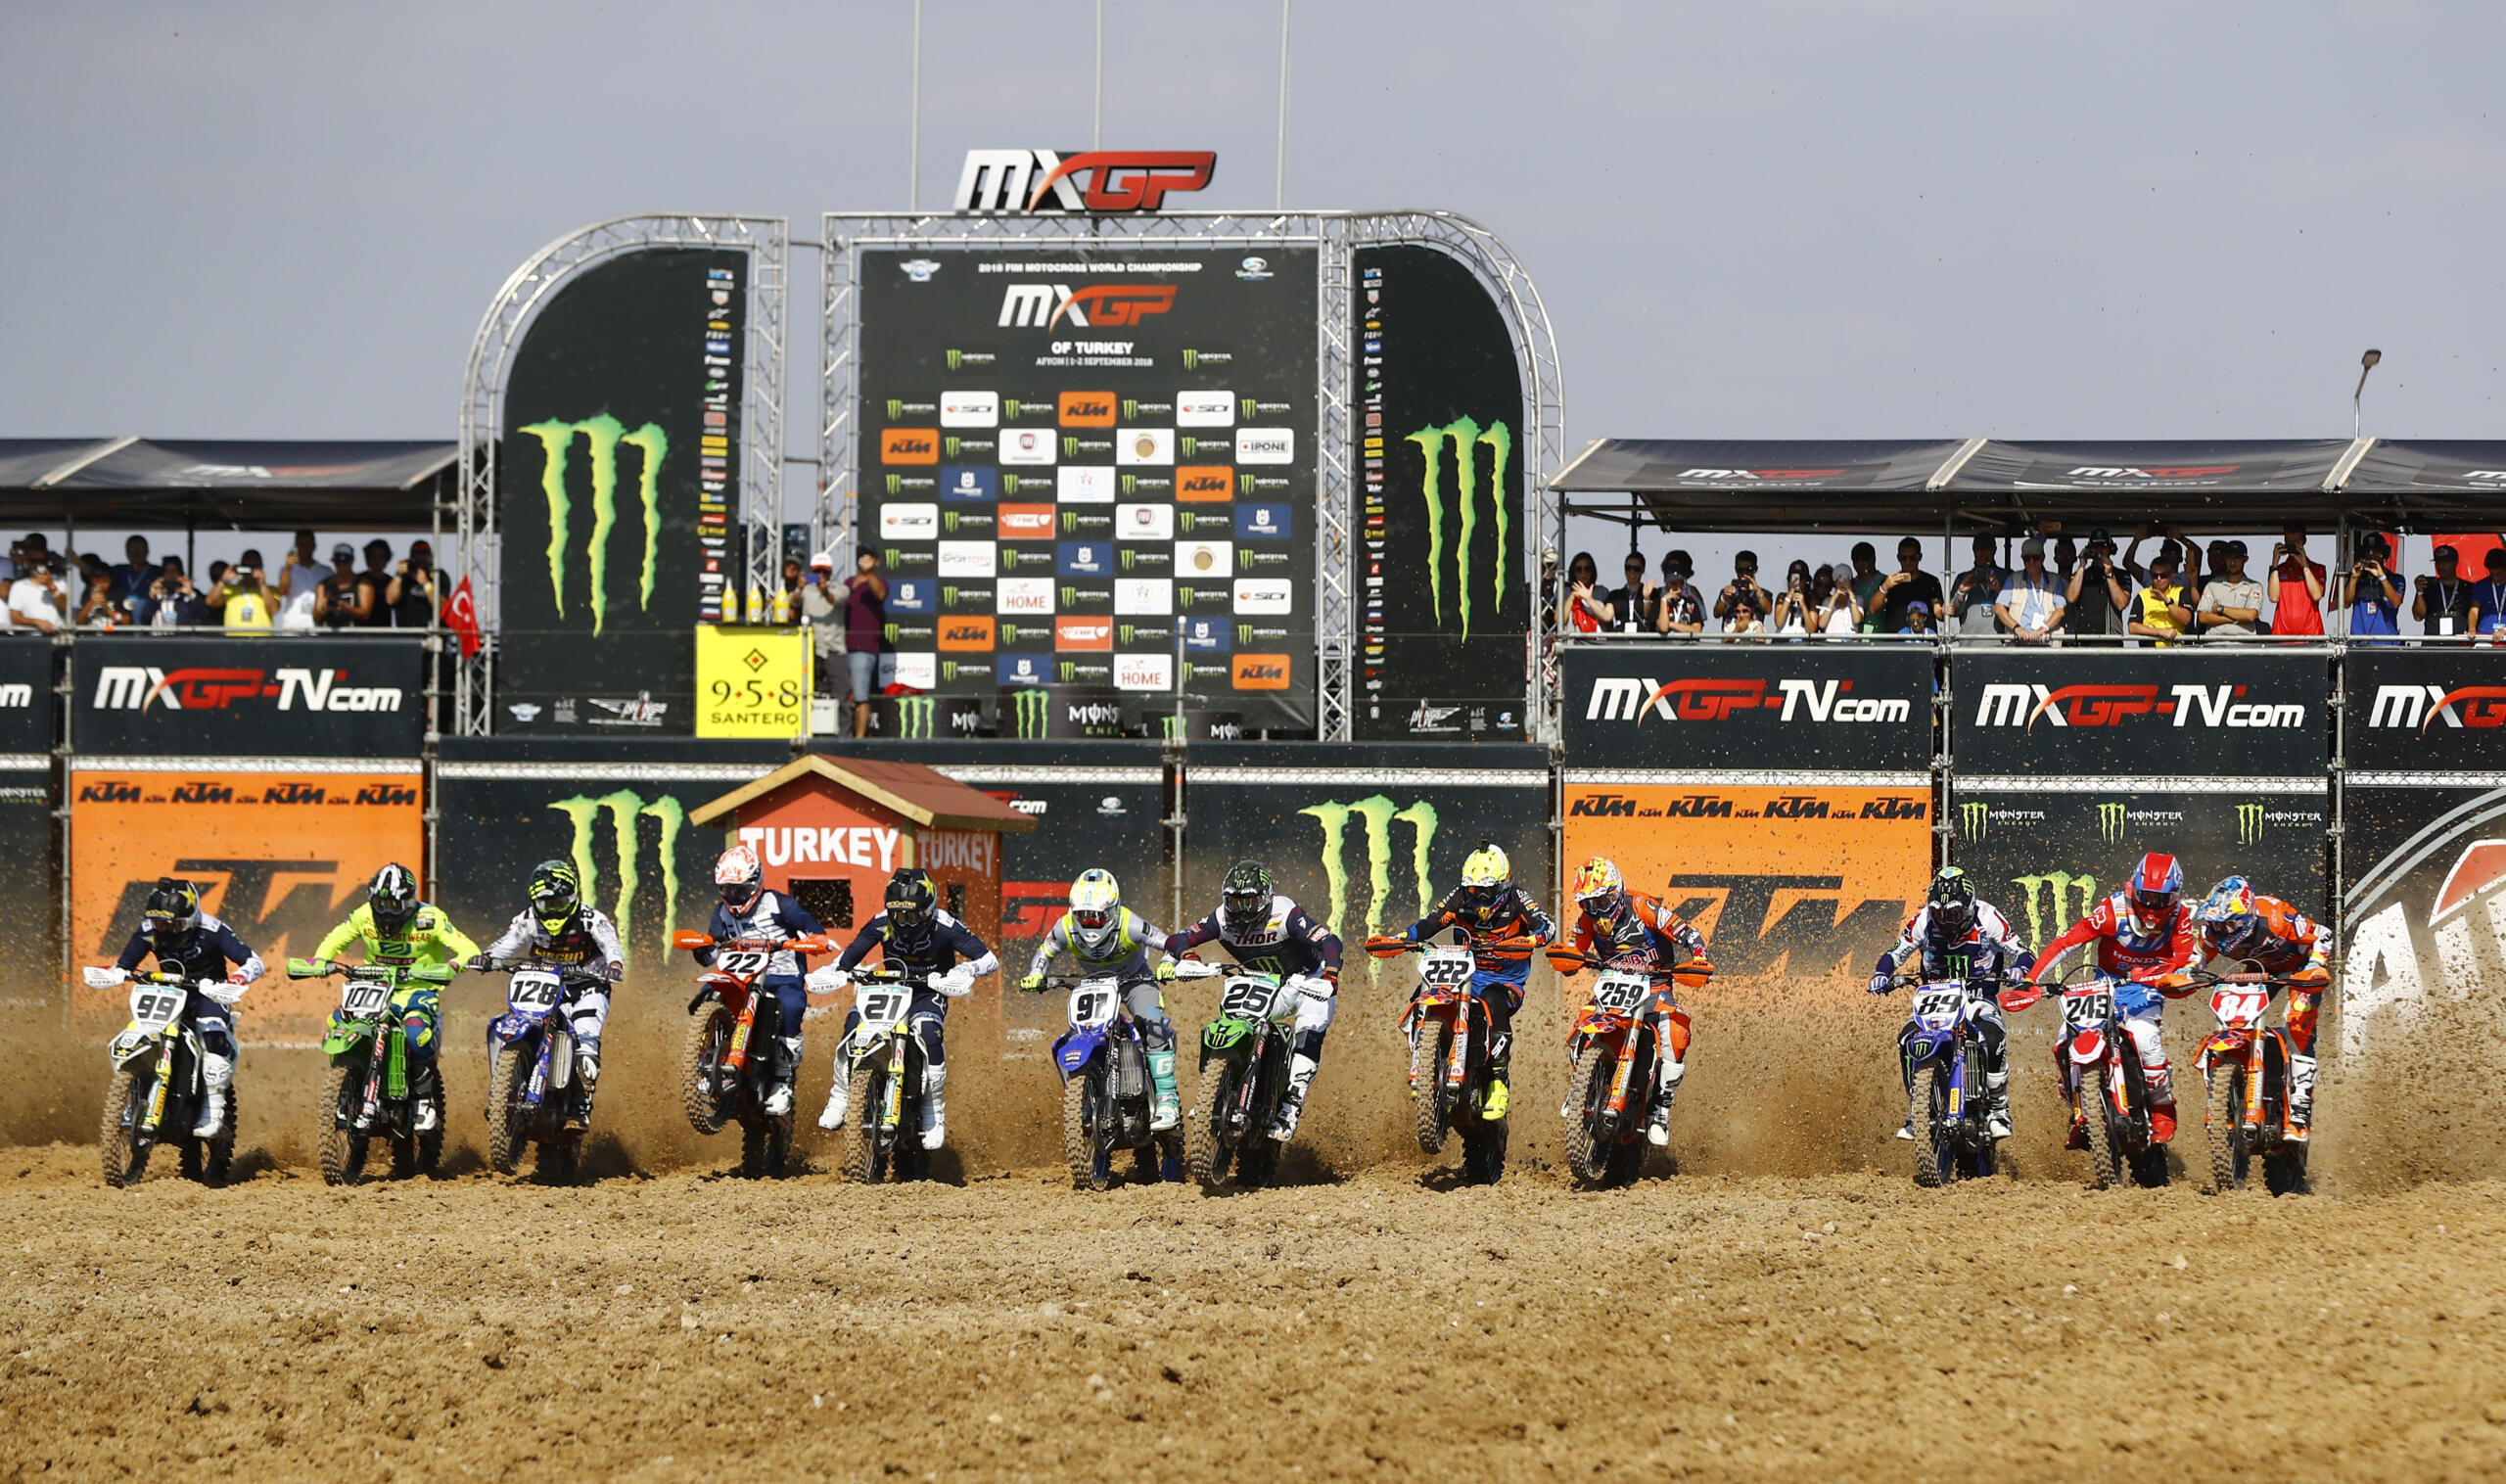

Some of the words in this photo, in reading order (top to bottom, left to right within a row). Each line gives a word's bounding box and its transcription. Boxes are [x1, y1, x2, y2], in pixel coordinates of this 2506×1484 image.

[953, 149, 1216, 211] MXGP
[1005, 262, 1024, 273] FIM
[1025, 262, 1088, 273] MOTOCROSS
[1089, 262, 1126, 273] WORLD
[1127, 262, 1203, 273] CHAMPIONSHIP
[998, 284, 1178, 335] MXGP
[1050, 342, 1074, 354] OF
[1075, 342, 1134, 354] TURKEY
[1084, 356, 1133, 367] SEPTEMBER
[1065, 401, 1109, 416] KTM
[889, 439, 932, 454] KTM
[1250, 441, 1286, 451] IPONE
[1677, 468, 1846, 480] MXGP
[2066, 465, 2242, 478] MXGP
[1183, 477, 1227, 491] KTM
[1005, 595, 1045, 609] HOME
[945, 626, 988, 641] KTM
[1122, 672, 1162, 685] HOME
[1239, 665, 1282, 679] KTM
[711, 712, 799, 725] SANTERO
[79, 781, 141, 803] KTM
[171, 782, 233, 804] KTM
[263, 783, 324, 805] KTM
[354, 784, 416, 806] KTM
[1570, 794, 1637, 817] KTM
[1666, 795, 1733, 818] KTM
[1763, 796, 1830, 818] KTM
[1860, 797, 1926, 819] KTM
[1989, 810, 2045, 820] MONSTER
[2127, 810, 2184, 820] MONSTER
[2265, 812, 2322, 822] MONSTER
[739, 826, 900, 873] TURKEY
[916, 830, 996, 877] TURKEY
[1234, 932, 1278, 946] THOR
[721, 953, 762, 973] 22
[2113, 951, 2157, 965] HOND
[1425, 960, 1470, 984] 222
[345, 987, 384, 1009] 100
[511, 980, 559, 1005] 128
[1224, 983, 1273, 1013] 25
[1600, 982, 1645, 1006] 259
[137, 995, 177, 1021] 99
[864, 995, 903, 1020] 21
[1917, 994, 1963, 1015] 89
[2066, 995, 2110, 1024] 243
[2219, 995, 2261, 1023] 84
